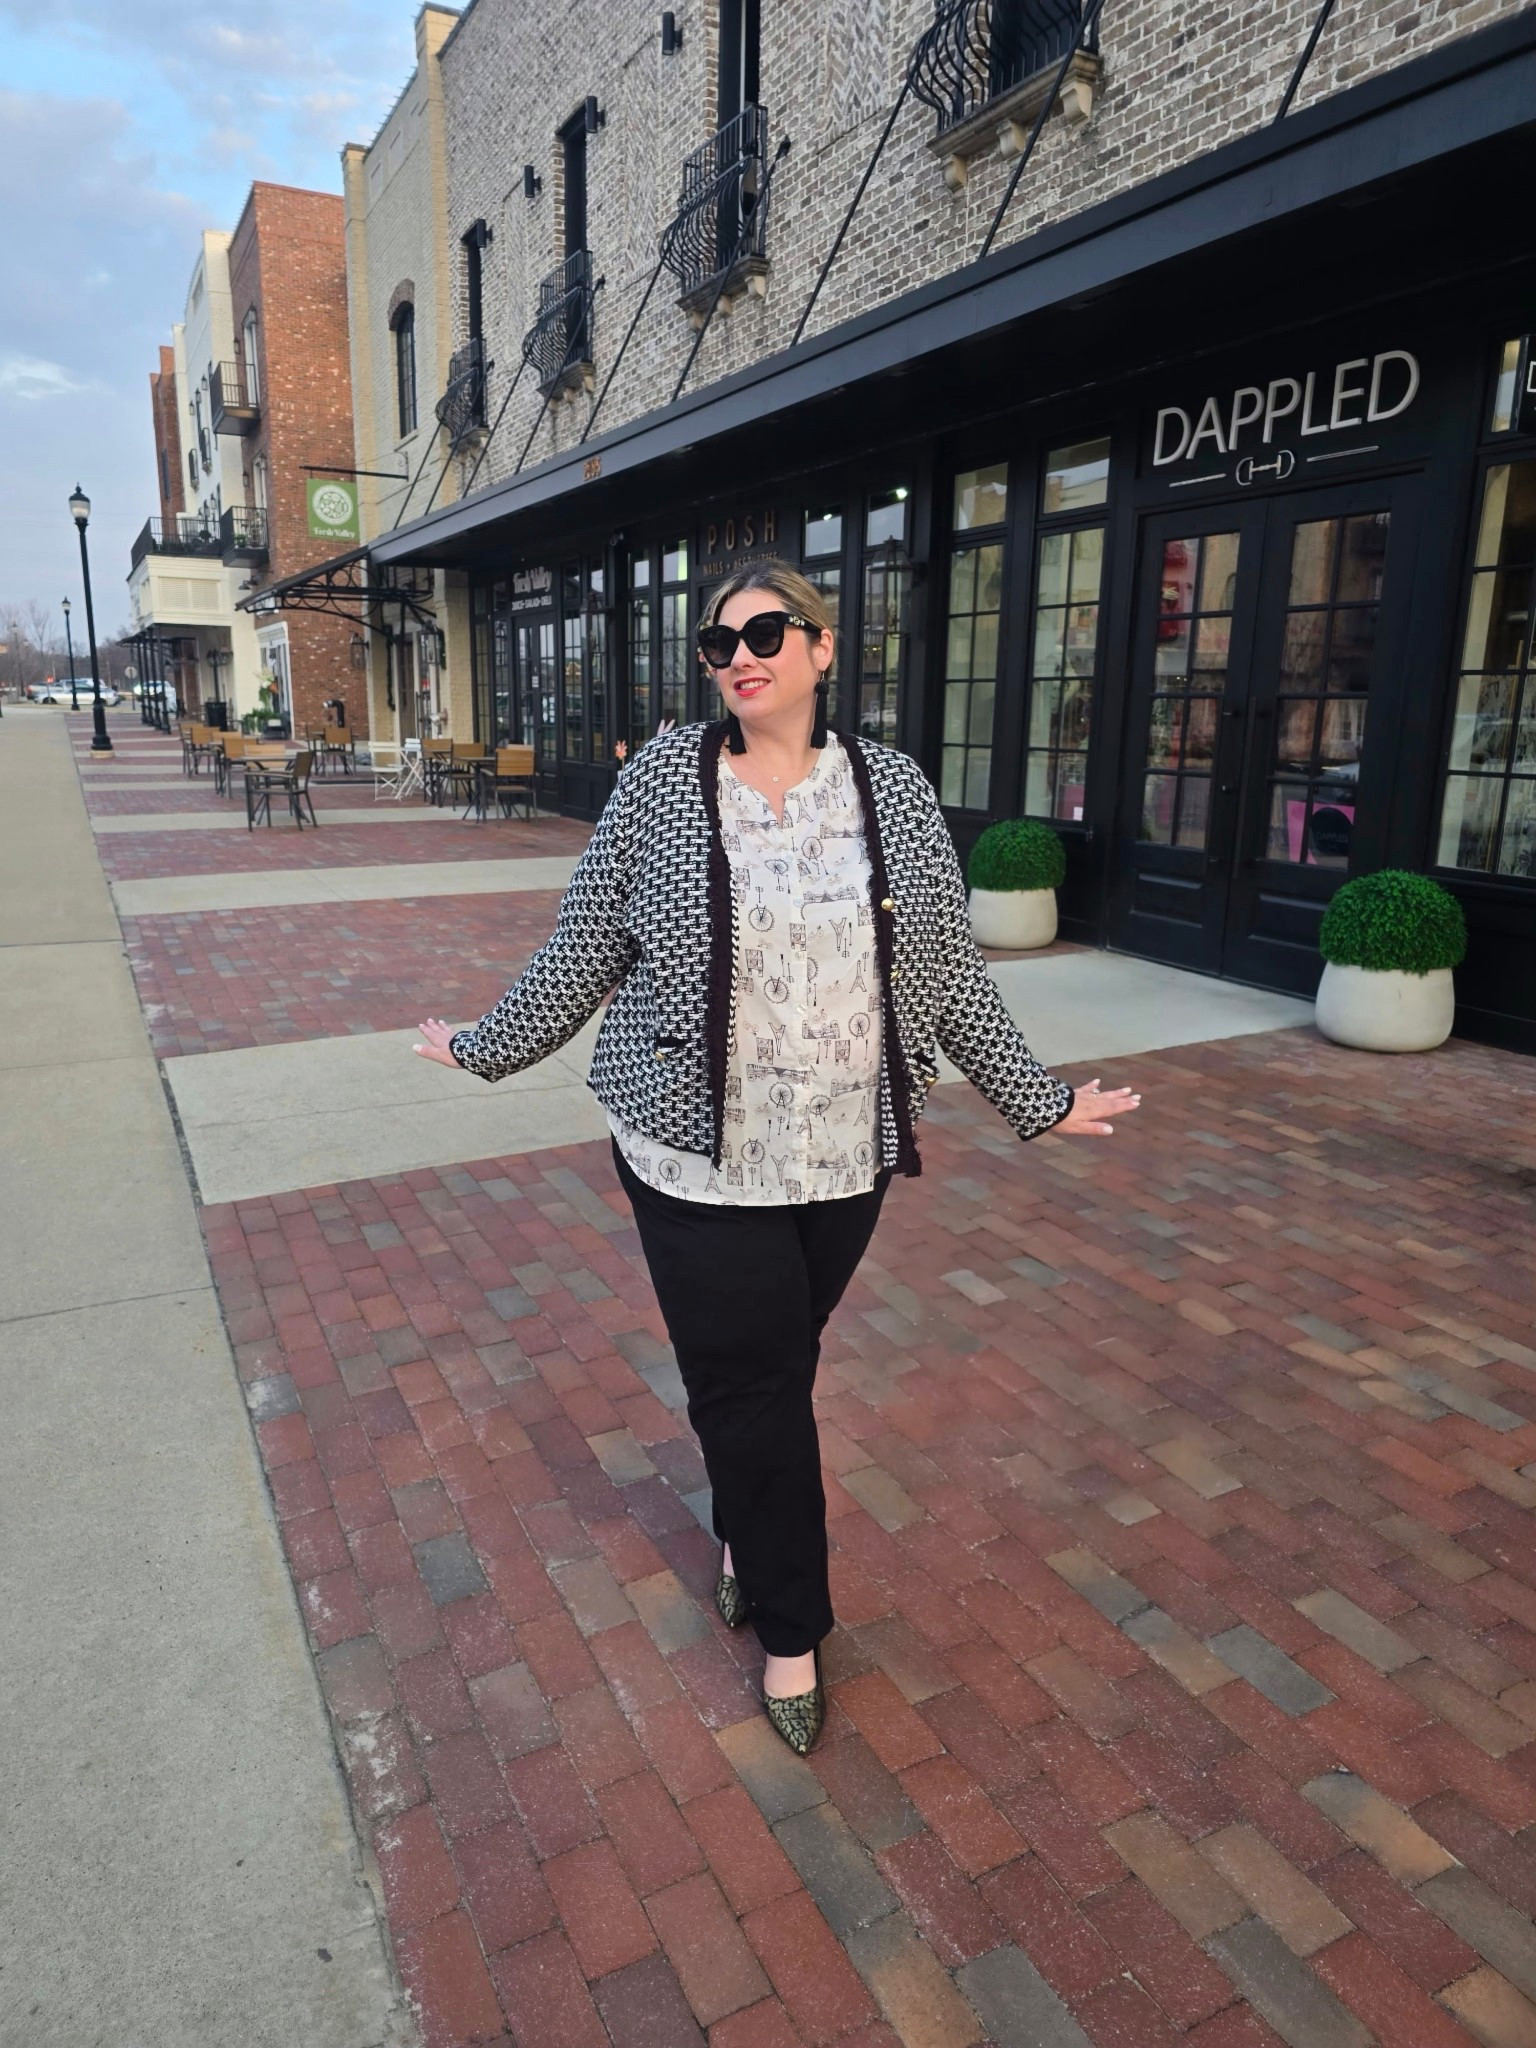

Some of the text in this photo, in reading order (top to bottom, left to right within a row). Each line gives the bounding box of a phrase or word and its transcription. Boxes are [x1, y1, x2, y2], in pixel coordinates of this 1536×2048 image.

[1153, 350, 1420, 466] DAPPLED
[707, 511, 775, 555] POSH
[703, 561, 723, 577] NAILS
